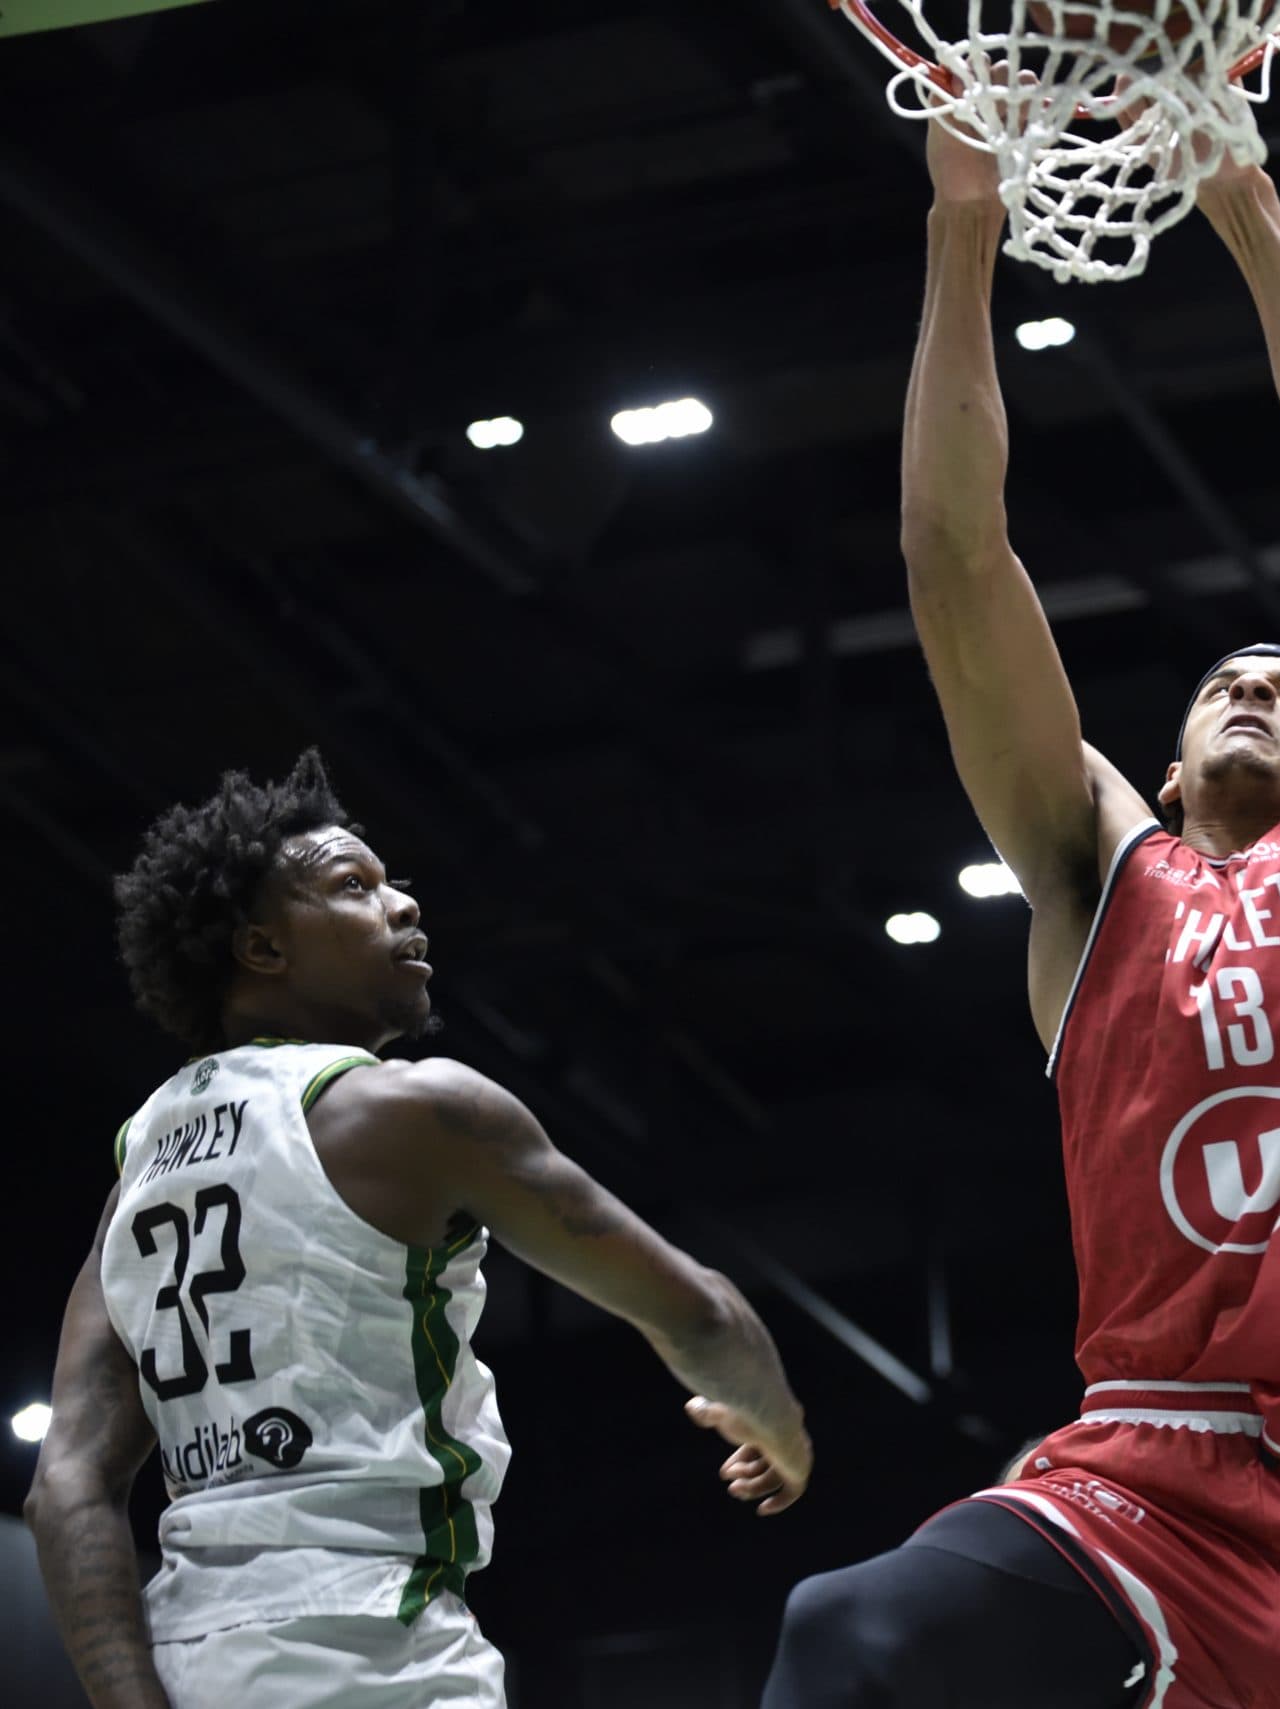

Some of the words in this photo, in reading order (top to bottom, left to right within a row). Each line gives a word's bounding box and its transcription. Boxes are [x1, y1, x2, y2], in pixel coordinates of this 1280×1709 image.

[1189, 966, 1274, 1070] 13
[139, 1100, 248, 1187] HAWLEY
[131, 1183, 257, 1402] 32
